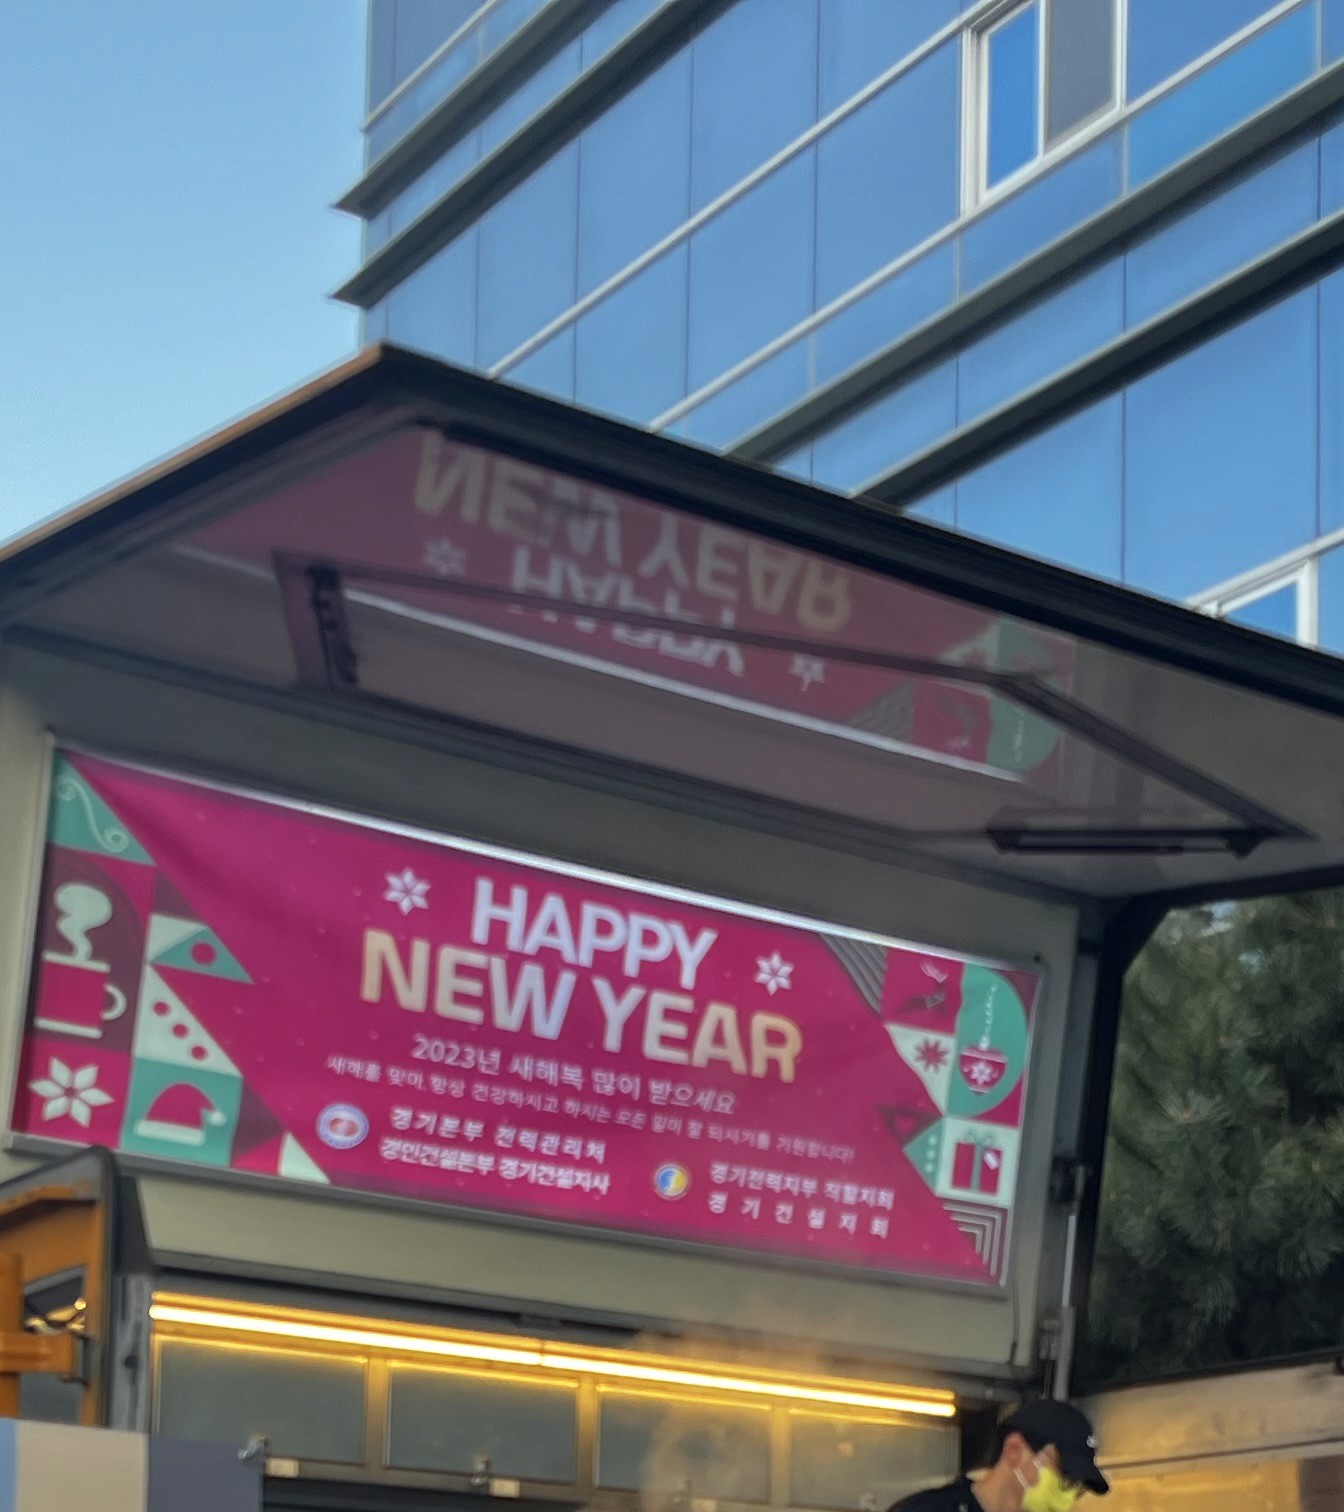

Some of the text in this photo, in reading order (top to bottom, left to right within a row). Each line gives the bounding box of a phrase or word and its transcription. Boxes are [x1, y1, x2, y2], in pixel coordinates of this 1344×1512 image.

[470, 877, 718, 991] HAPPY
[360, 929, 804, 1084] NEW YEAR
[411, 1034, 736, 1115] 2023년 새해복 많이 받으세요
[380, 1137, 611, 1196] 경인건설본부 경기건설지사
[391, 1105, 607, 1164] 경기본부 전력관리처
